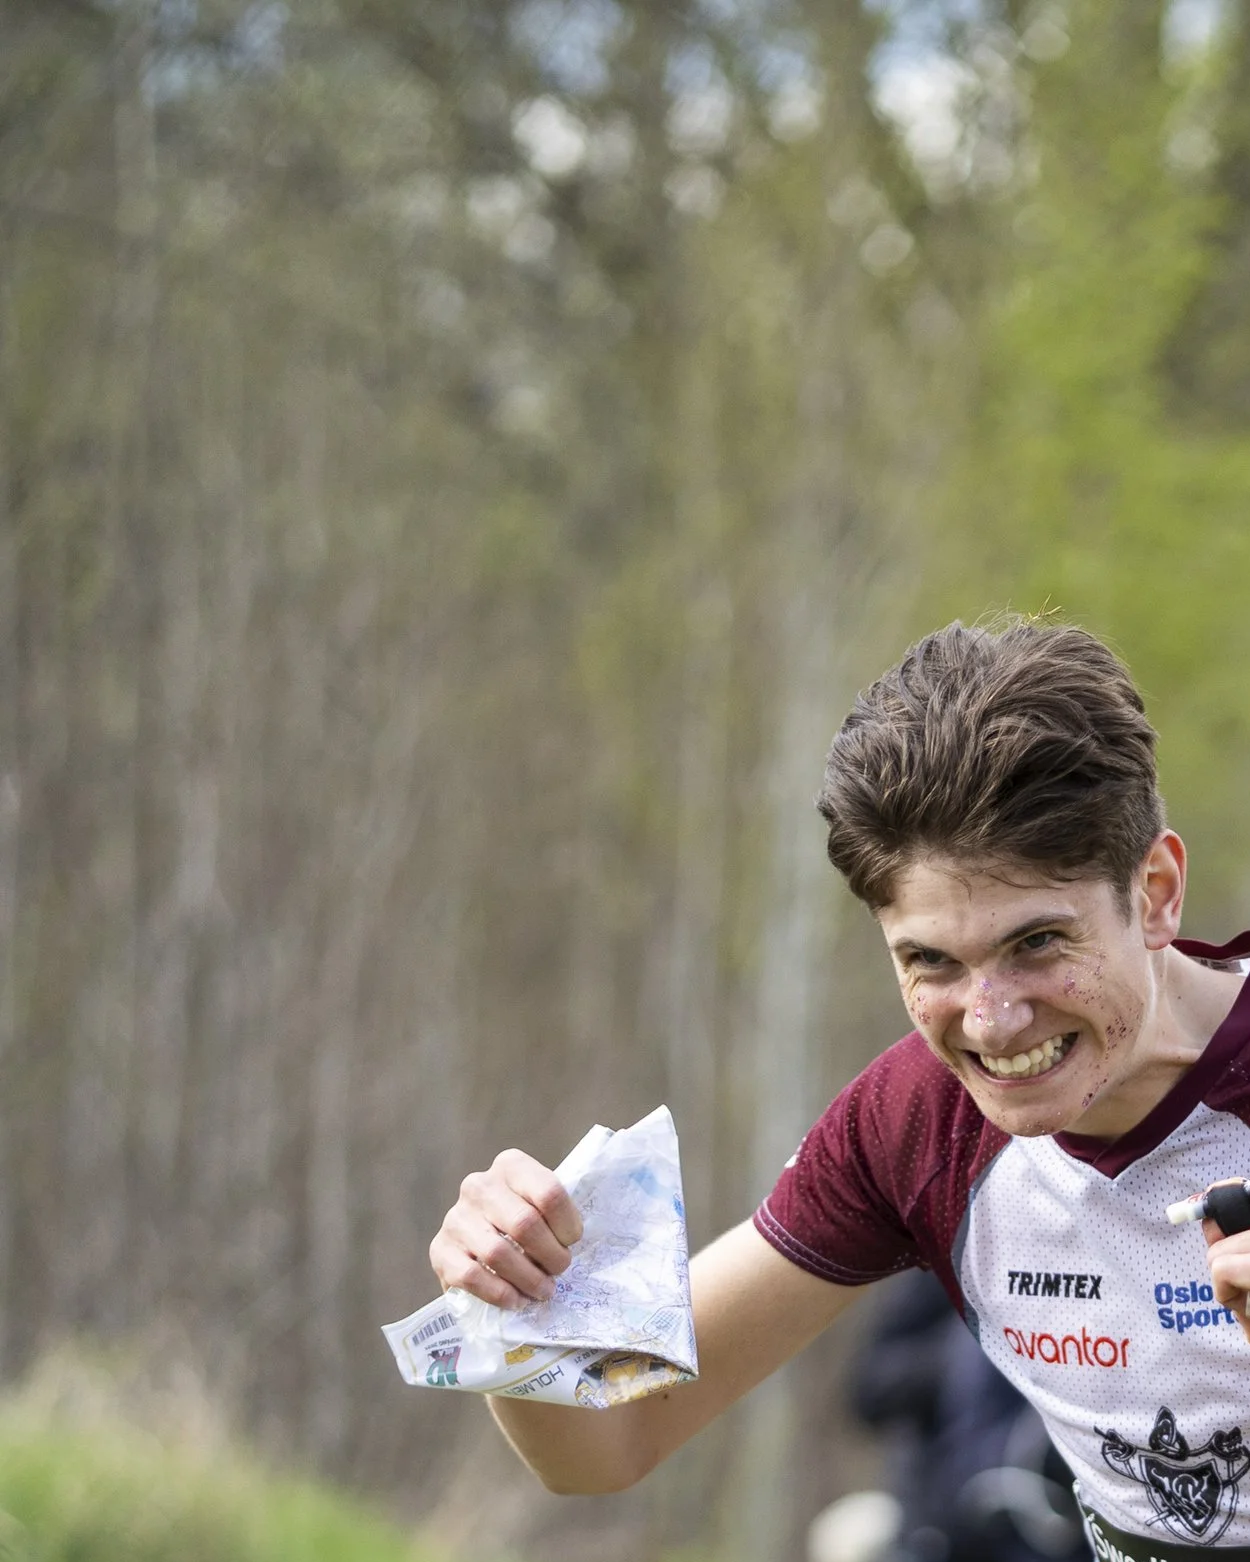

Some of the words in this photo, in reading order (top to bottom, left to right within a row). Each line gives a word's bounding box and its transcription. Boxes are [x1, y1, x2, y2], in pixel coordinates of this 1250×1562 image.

[1007, 1271, 1102, 1299] TRIMTEX
[1154, 1281, 1214, 1305] Oslo
[1157, 1306, 1239, 1333] Sport
[1004, 1327, 1130, 1367] avantor
